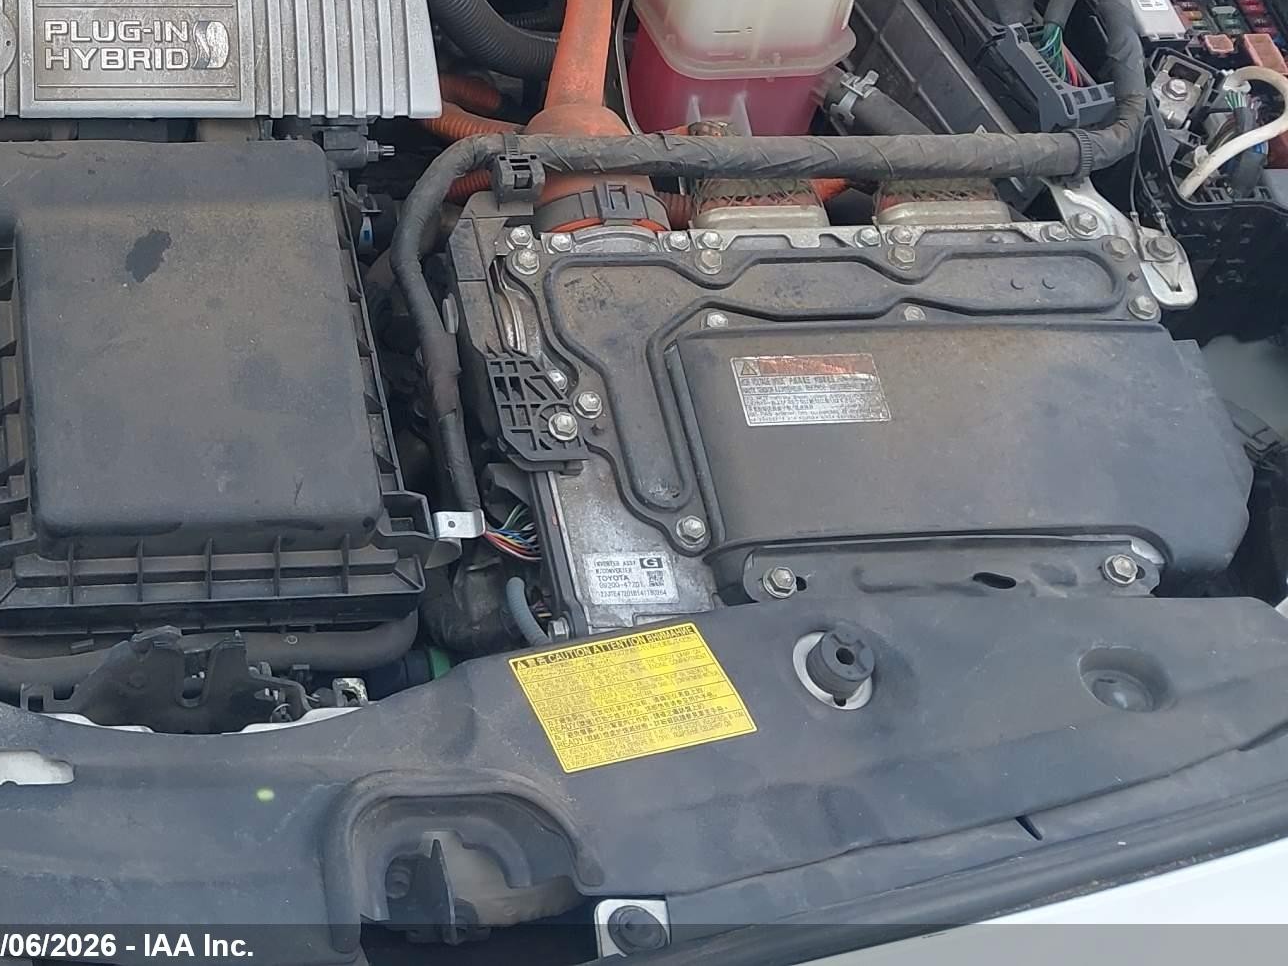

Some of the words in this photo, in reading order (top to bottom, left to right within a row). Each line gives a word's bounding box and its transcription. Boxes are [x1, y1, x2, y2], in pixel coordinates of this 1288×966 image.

[44, 20, 189, 42] PLUG-IN
[44, 48, 190, 69] HYBRID
[548, 647, 590, 662] CAUTION
[592, 636, 646, 654] ATTENTION
[646, 626, 694, 644] ВНИМАНИЕ
